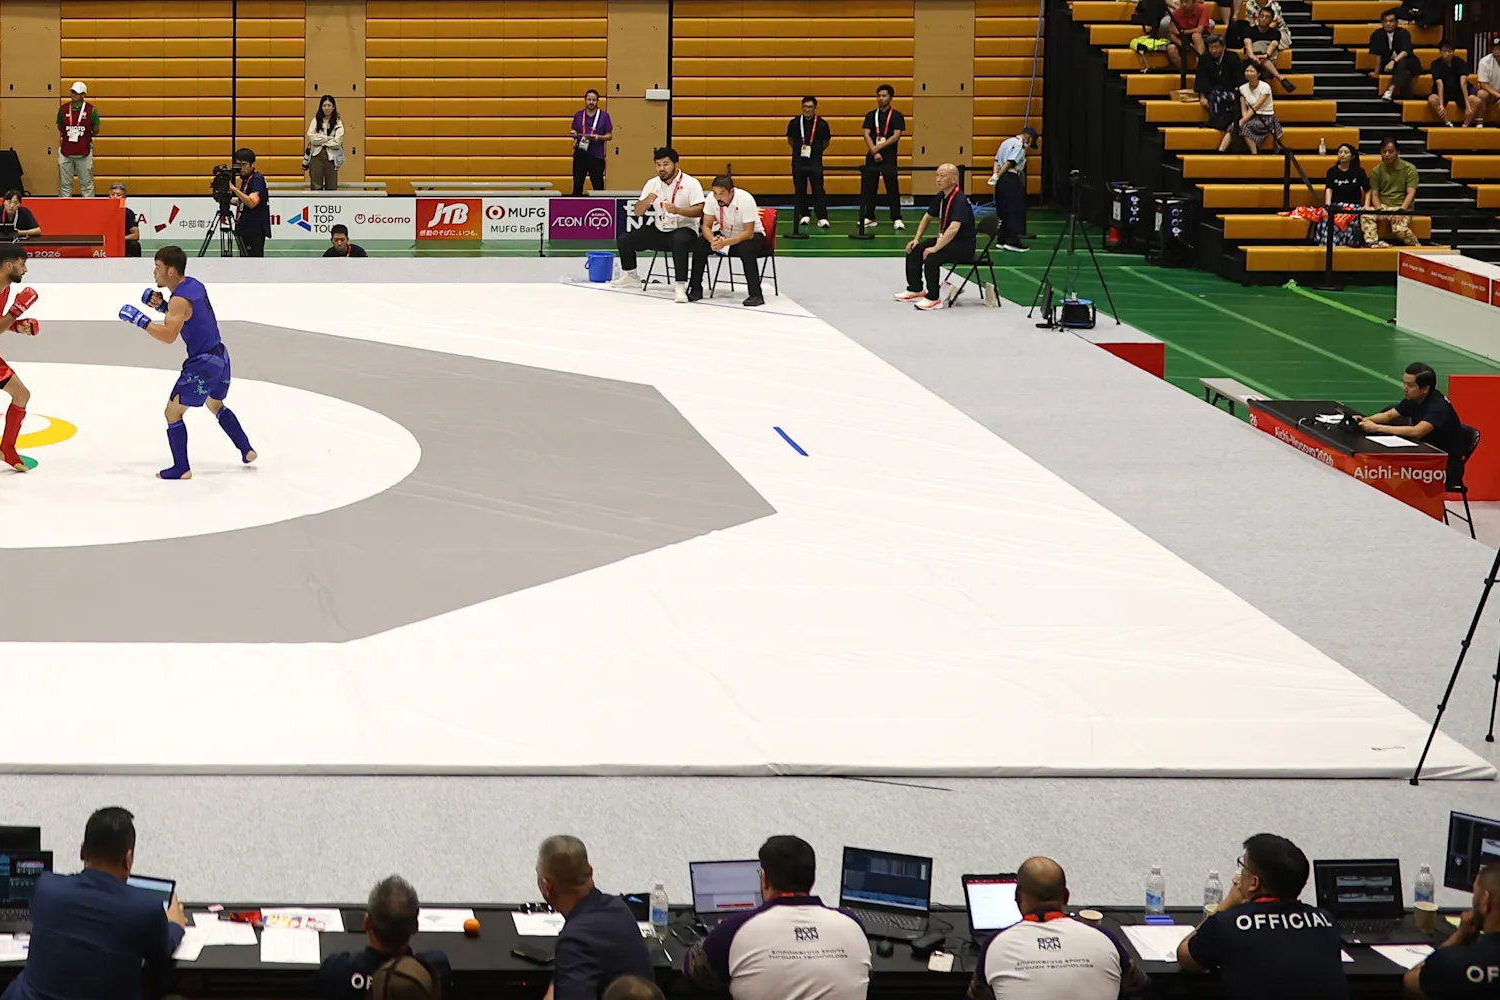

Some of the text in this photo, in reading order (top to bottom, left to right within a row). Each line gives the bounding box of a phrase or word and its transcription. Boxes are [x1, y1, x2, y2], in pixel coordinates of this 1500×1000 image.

[313, 204, 342, 214] TOBU
[508, 207, 546, 218] MUFG
[313, 214, 334, 223] TOP
[368, 215, 411, 224] docomo
[428, 203, 469, 228] JTB
[490, 224, 517, 233] MUFG
[35, 250, 61, 258] 2026
[1274, 427, 1334, 467] Aichi-Nagoya 2026
[1236, 912, 1333, 931] OFFICIAL
